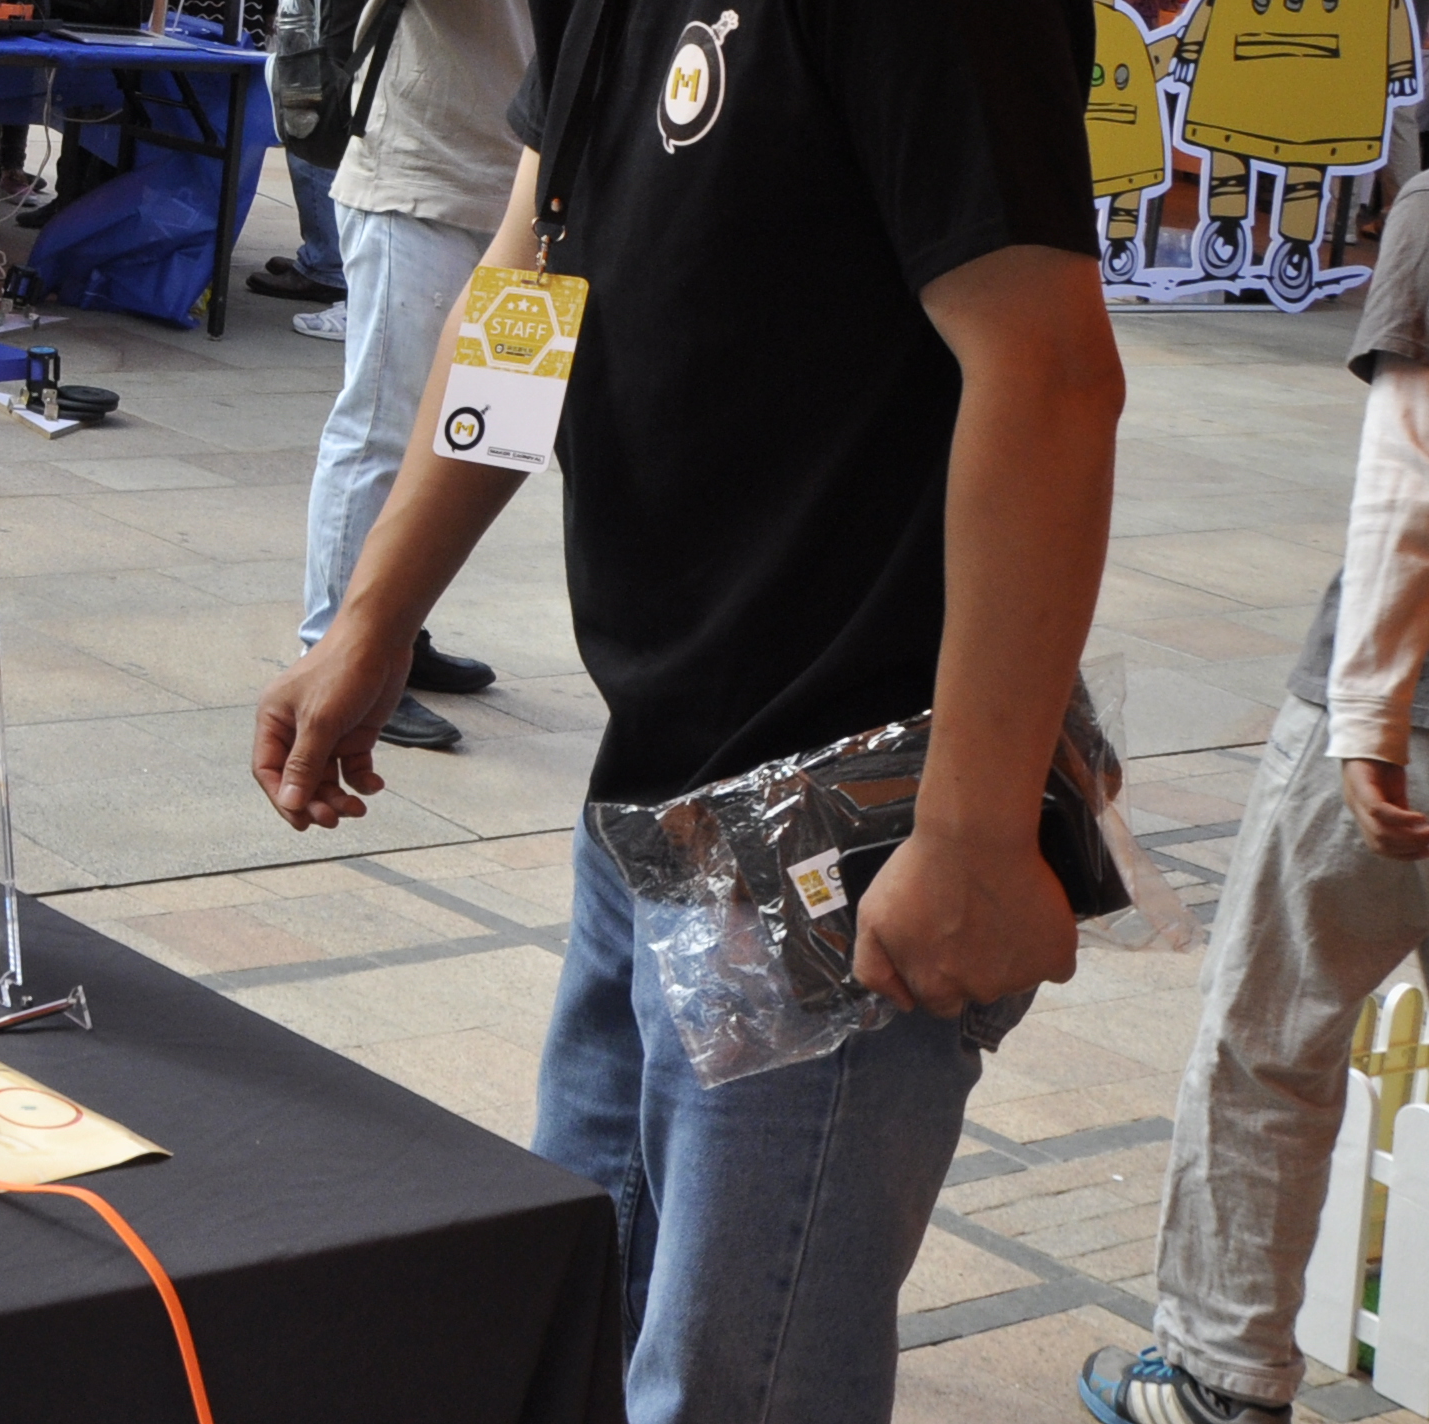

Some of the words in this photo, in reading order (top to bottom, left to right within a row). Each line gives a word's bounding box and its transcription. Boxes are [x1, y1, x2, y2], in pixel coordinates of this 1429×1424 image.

[670, 67, 701, 103] M
[490, 317, 548, 340] STAFF
[454, 421, 476, 438] M
